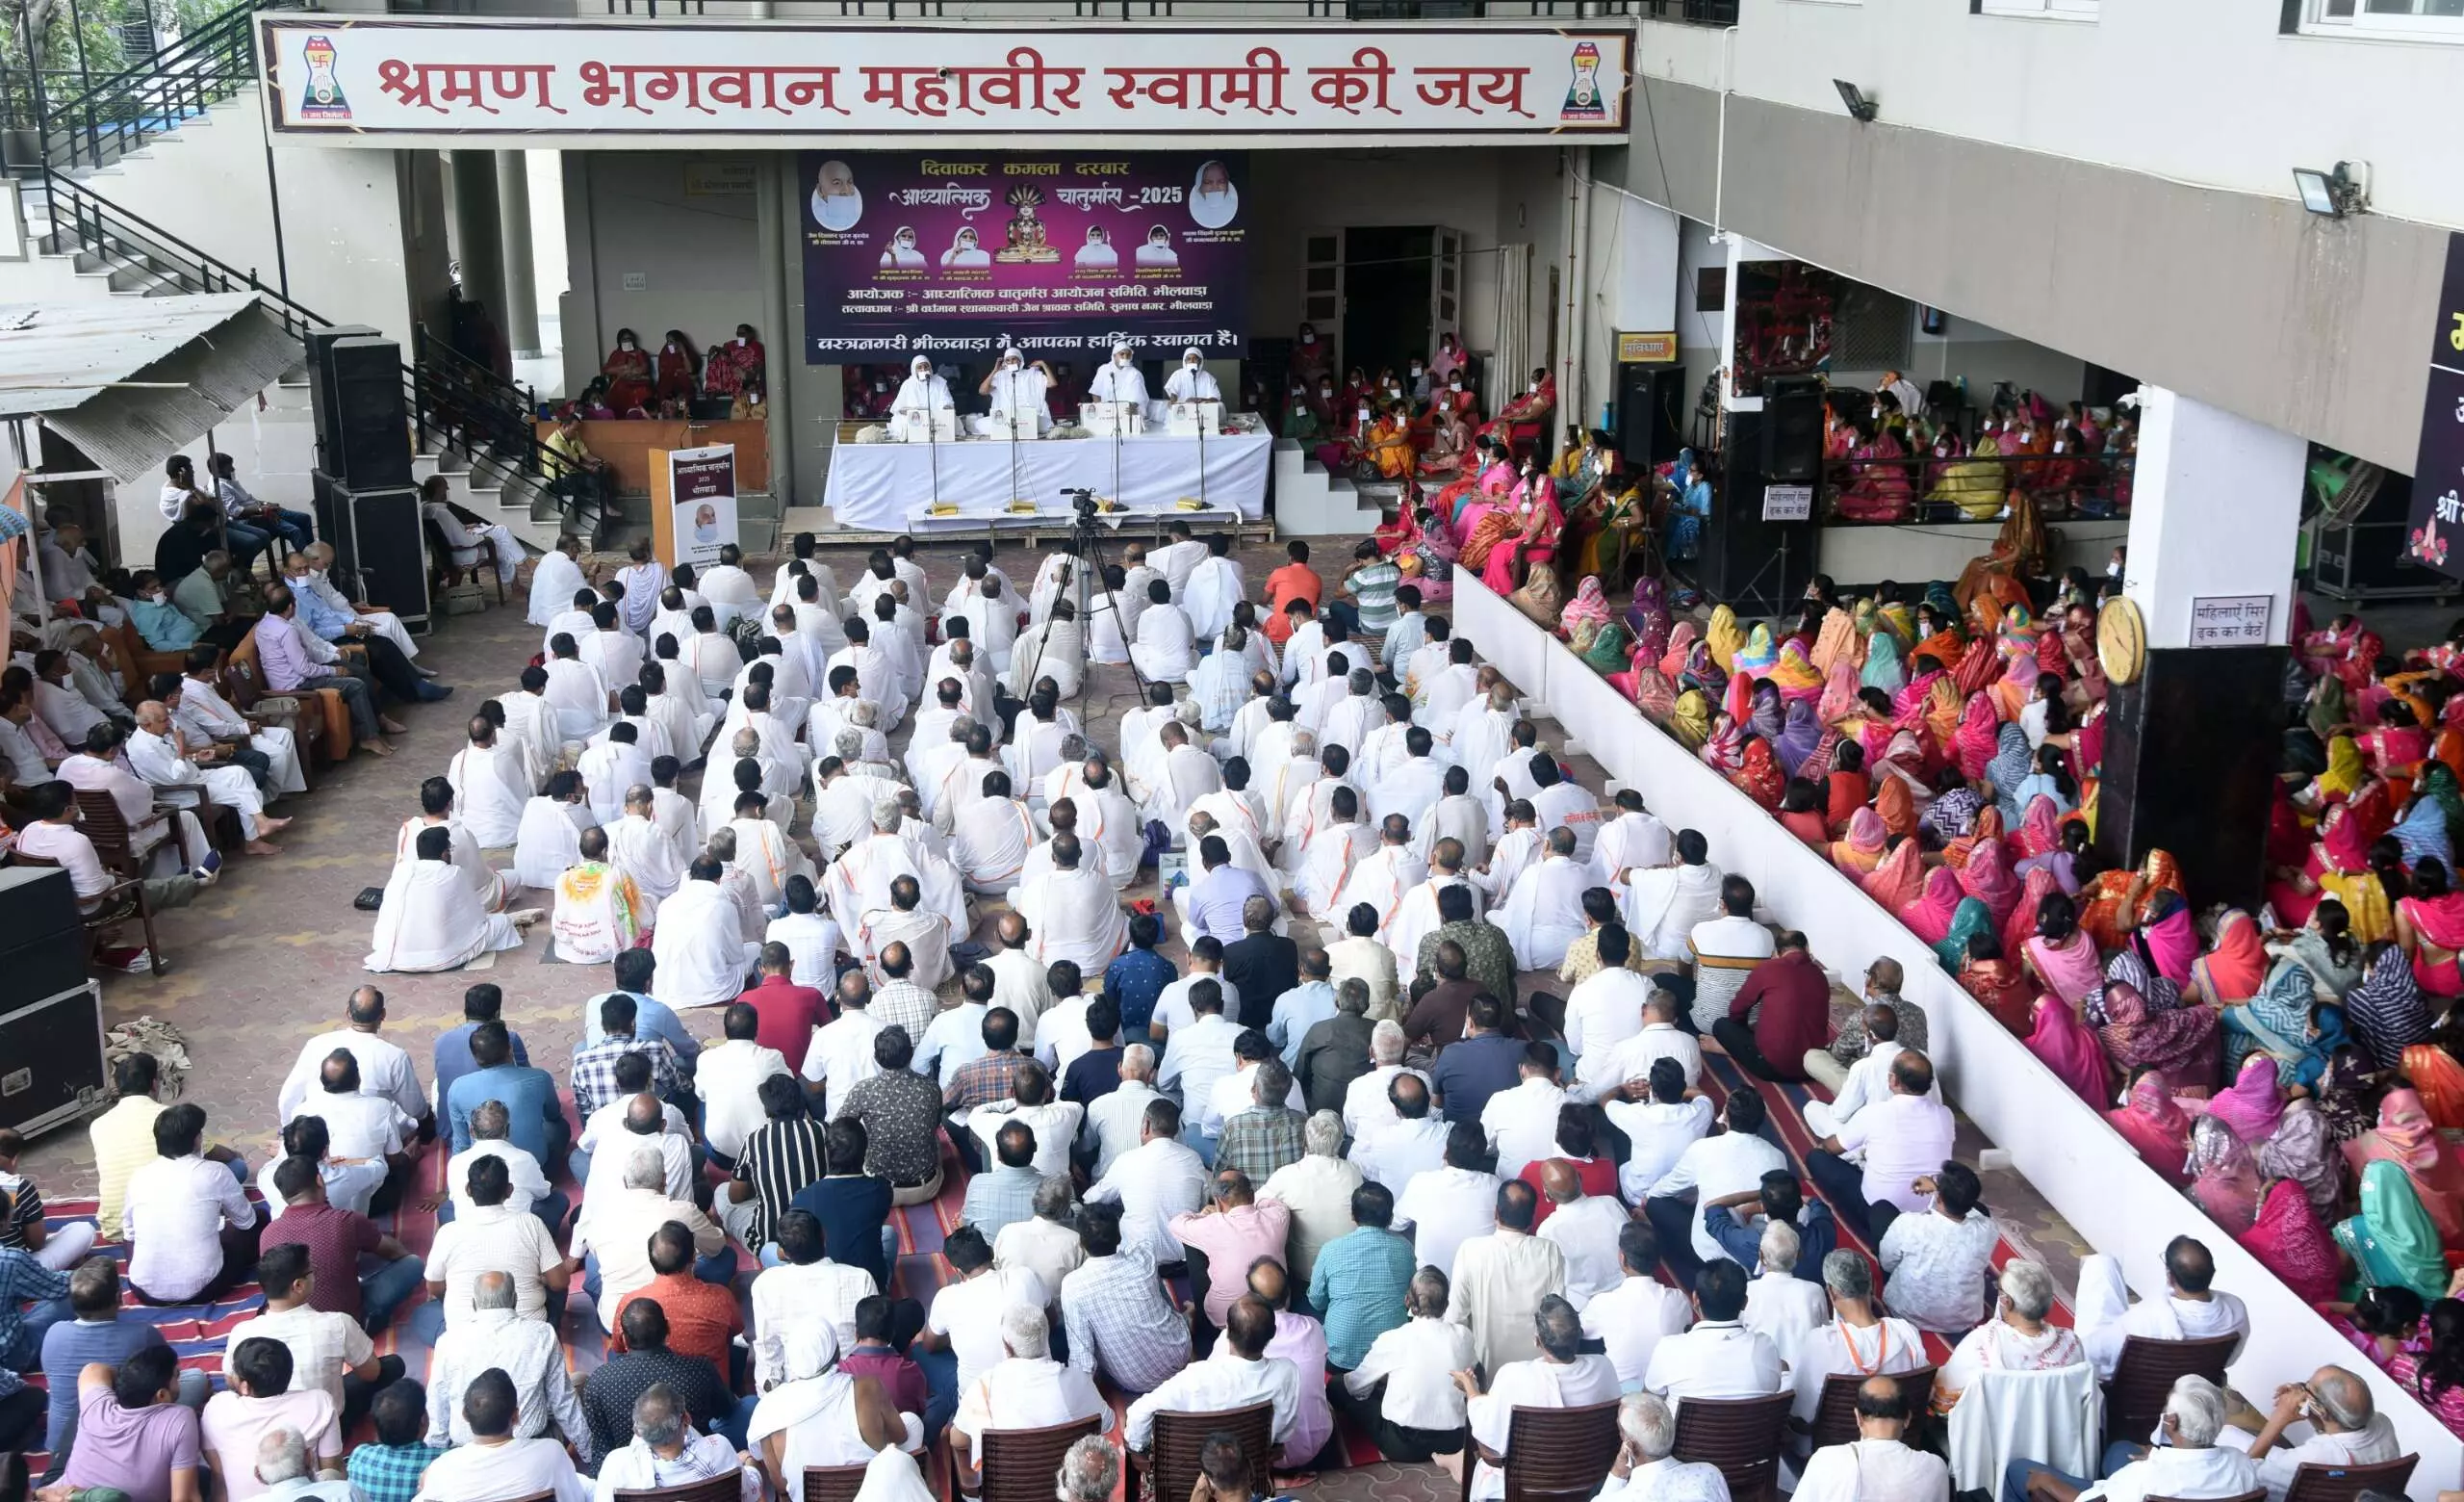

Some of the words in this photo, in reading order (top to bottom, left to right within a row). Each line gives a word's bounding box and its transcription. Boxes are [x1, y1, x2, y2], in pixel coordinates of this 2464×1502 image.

[378, 59, 568, 115] श्रमण
[578, 60, 851, 116] भगवान
[859, 46, 1086, 117] महावीर
[1104, 46, 1297, 116] स्वामी
[1307, 46, 1402, 116] की
[1413, 67, 1536, 118] जय
[920, 159, 989, 175] दिवाकर
[1003, 162, 1062, 175] कमला
[1075, 162, 1131, 174] दरबार
[888, 182, 992, 220] आध्यात्मिक
[1056, 181, 1142, 213] चातुर्मास
[847, 288, 904, 299] आयोजक
[922, 287, 994, 299] आध्यात्मिक
[998, 287, 1047, 300] चातुर्मास
[1051, 286, 1104, 298] आयोजन
[1153, 286, 1207, 298] भीलवाड़ा
[1021, 302, 1040, 313] जैन
[818, 334, 908, 350] वस्त्रनगरी
[912, 334, 990, 351] भीलवाड़ा
[996, 333, 1013, 350] में
[1016, 336, 1083, 349] आपका
[1151, 333, 1213, 348] स्वागत
